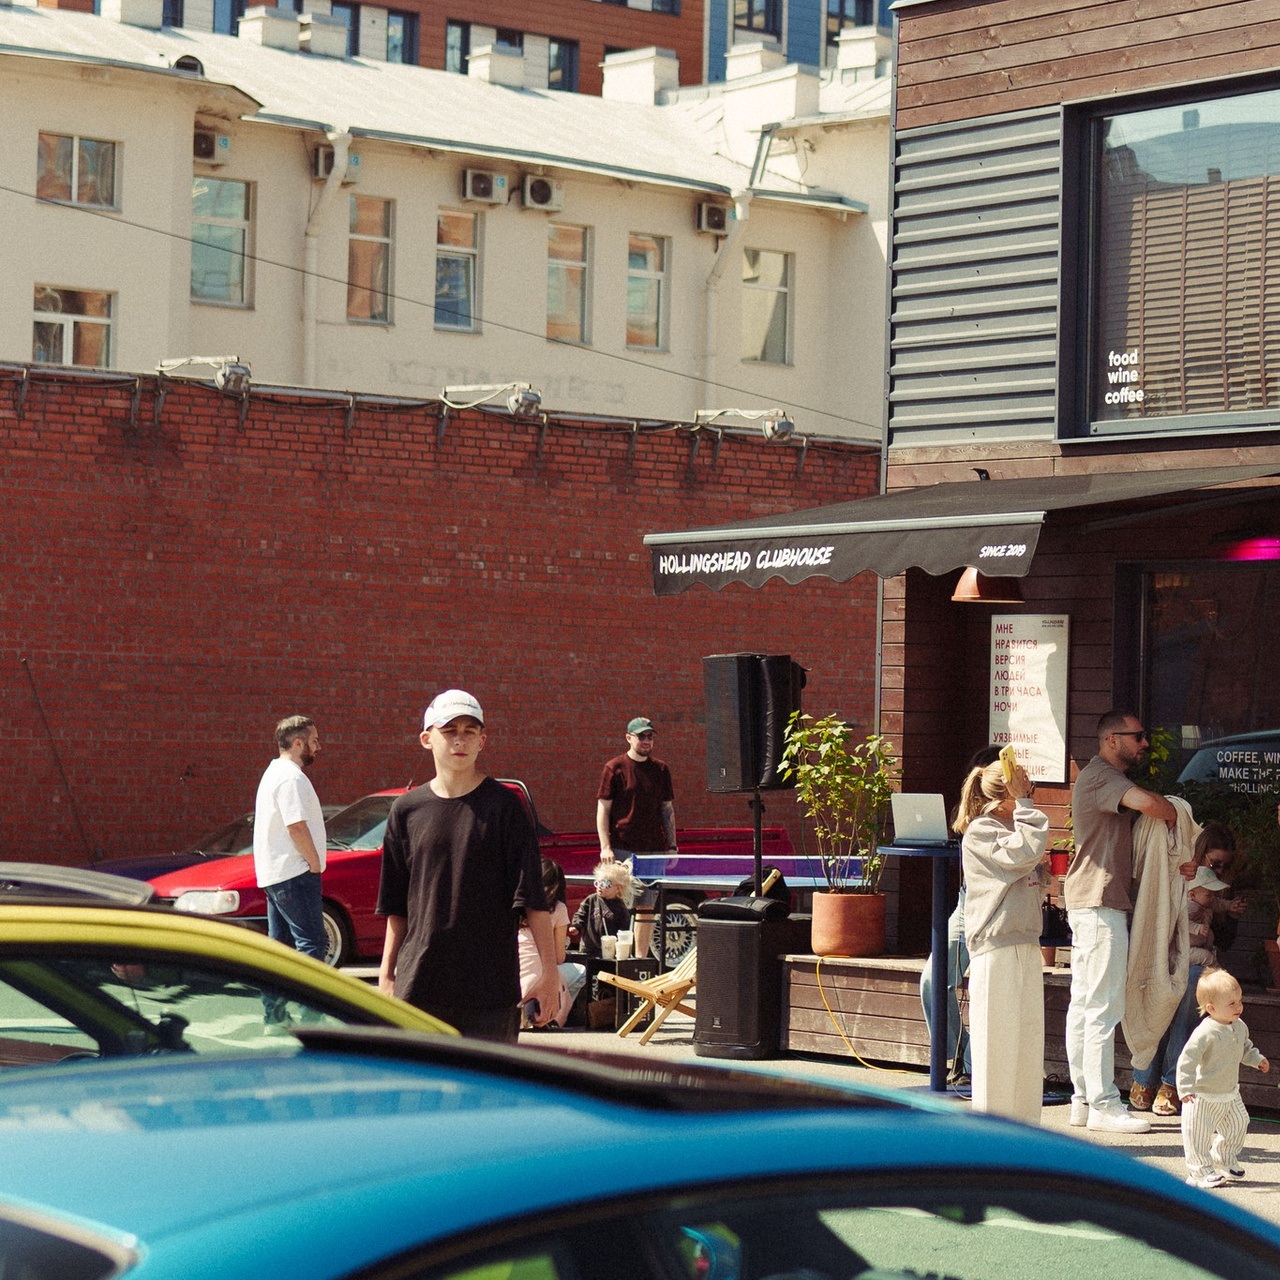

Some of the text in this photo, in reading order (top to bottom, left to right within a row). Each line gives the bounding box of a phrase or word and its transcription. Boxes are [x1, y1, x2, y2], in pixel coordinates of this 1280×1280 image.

[1108, 348, 1138, 367] food
[1107, 367, 1139, 384] wine
[1104, 386, 1145, 405] coffee
[979, 544, 1026, 558] SINCE 2019
[659, 546, 835, 574] HOLLINGSHEAD CLUBHOUSE
[995, 623, 1014, 634] МНЕ
[995, 639, 1039, 651] НРАВИТСЯ
[994, 654, 1026, 665] ВЕРСИЯ
[994, 668, 1026, 681] ЛЮДЕЙ
[994, 686, 1043, 697] В ТРИ ЧАСА
[1216, 751, 1261, 765] COFFEE,
[1219, 767, 1249, 779] MAKE
